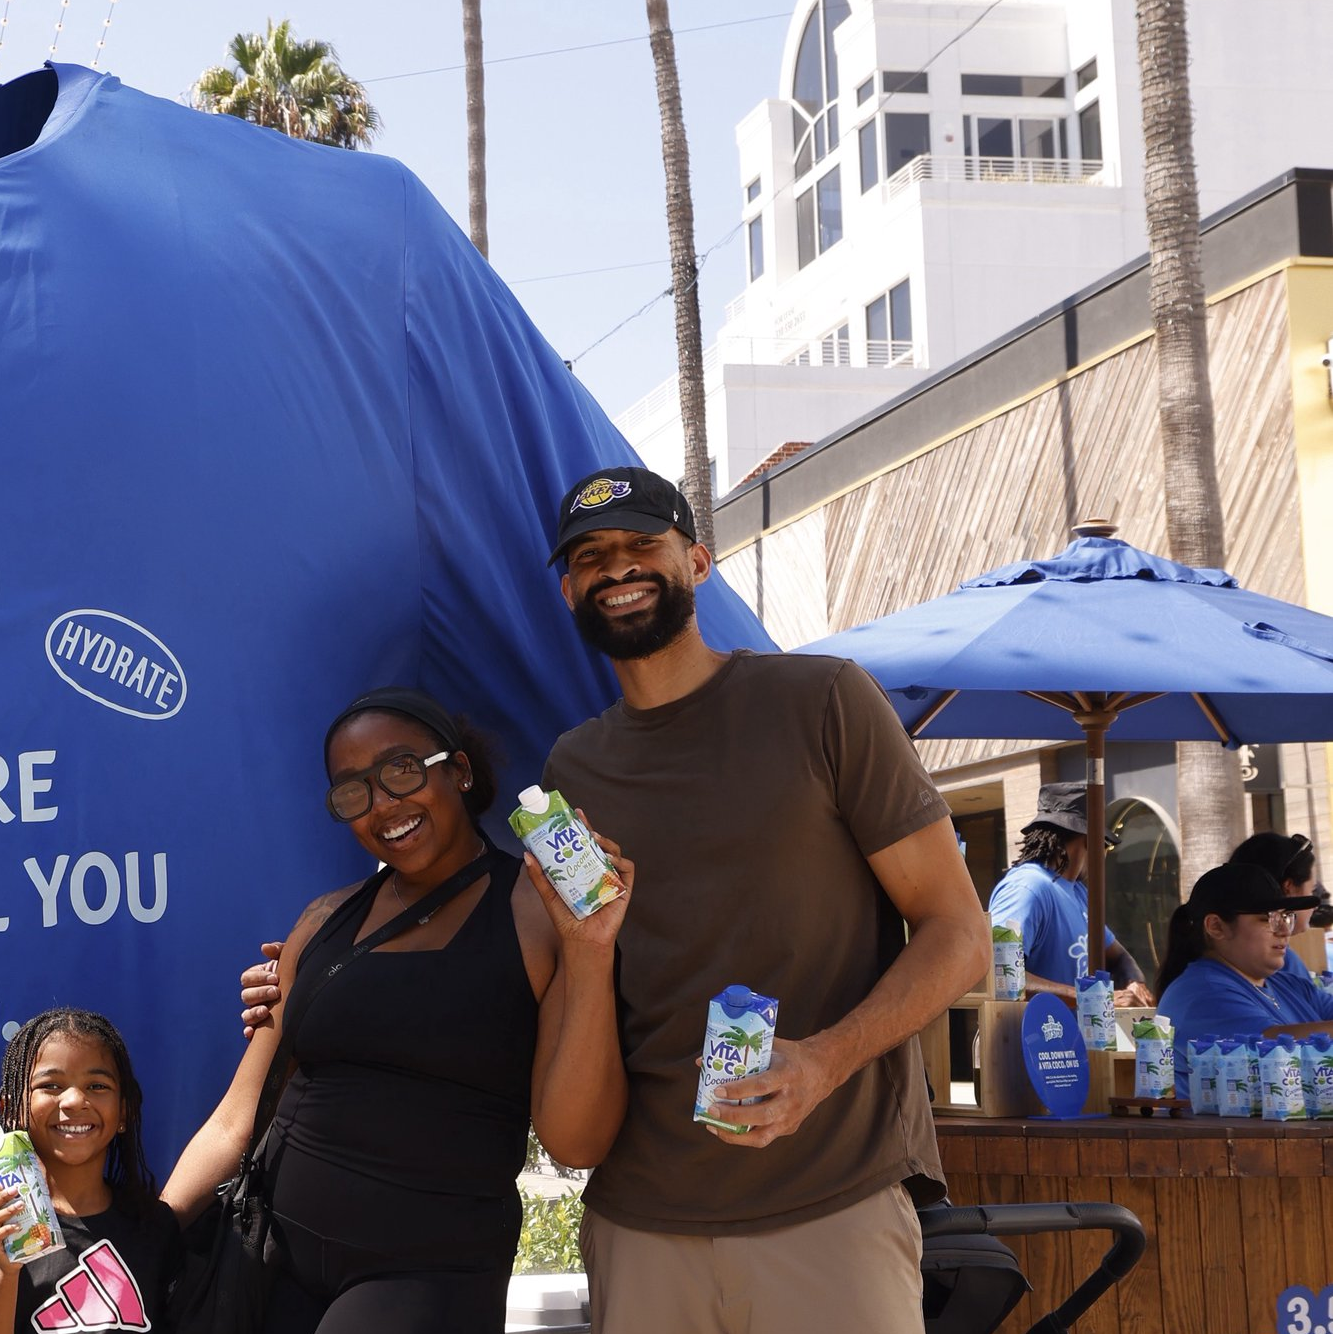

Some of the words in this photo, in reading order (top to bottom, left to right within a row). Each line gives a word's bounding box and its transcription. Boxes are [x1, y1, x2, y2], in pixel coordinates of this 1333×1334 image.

[56, 620, 179, 710] HYDRATE
[546, 827, 580, 850] VITA
[23, 851, 169, 929] YOU
[708, 1040, 742, 1062] VITA
[707, 1056, 746, 1076] COCO
[1282, 1077, 1300, 1086] COC
[1313, 1077, 1333, 1085] COC
